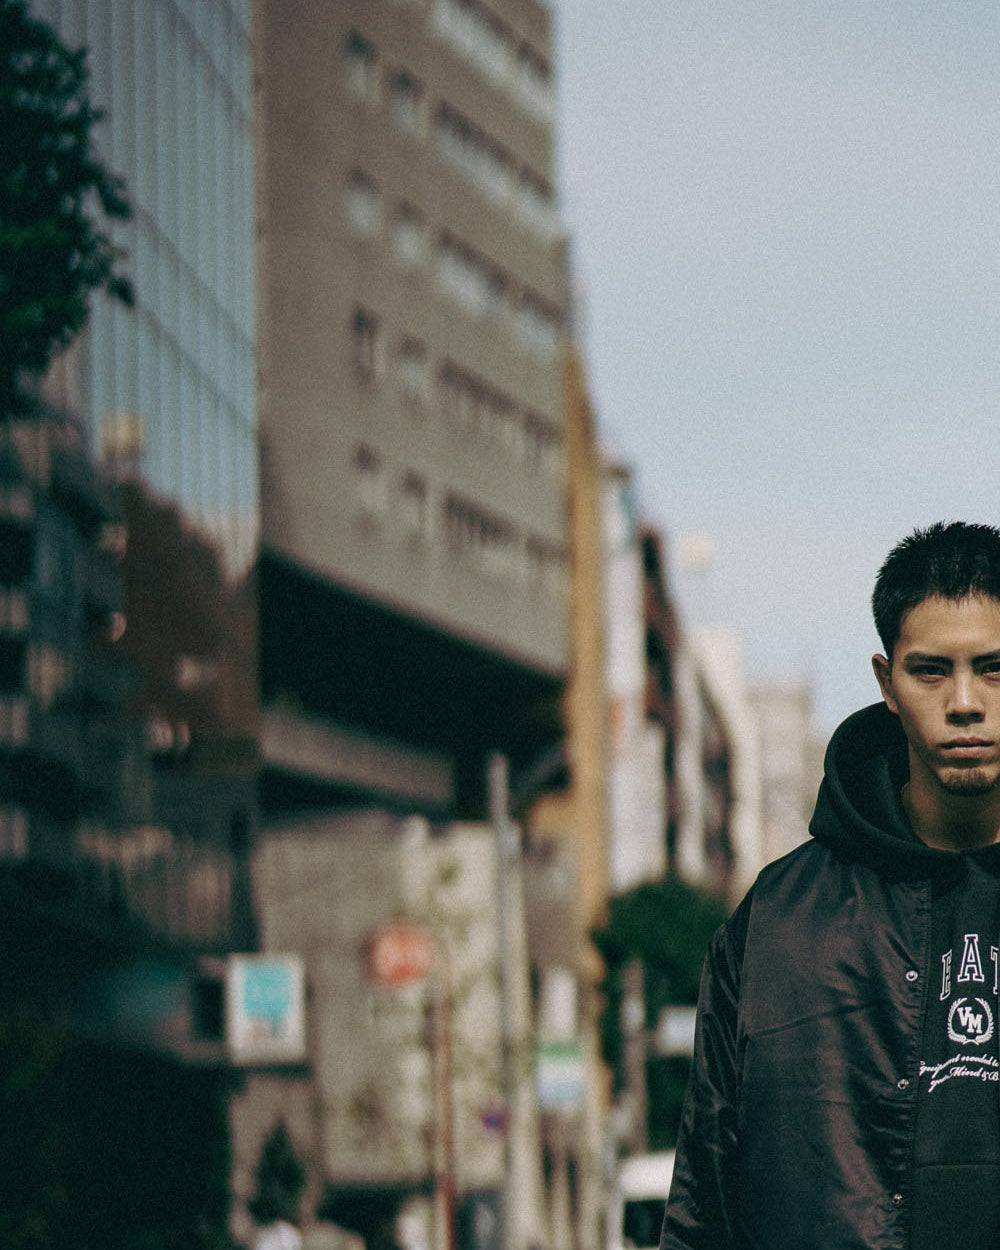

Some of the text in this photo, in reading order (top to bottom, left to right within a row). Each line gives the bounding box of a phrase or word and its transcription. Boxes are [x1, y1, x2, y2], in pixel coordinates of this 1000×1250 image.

[957, 1006, 983, 1034] VM
[961, 1053, 993, 1065] needed
[949, 1065, 983, 1077] Mind
[982, 1071, 989, 1081] &
